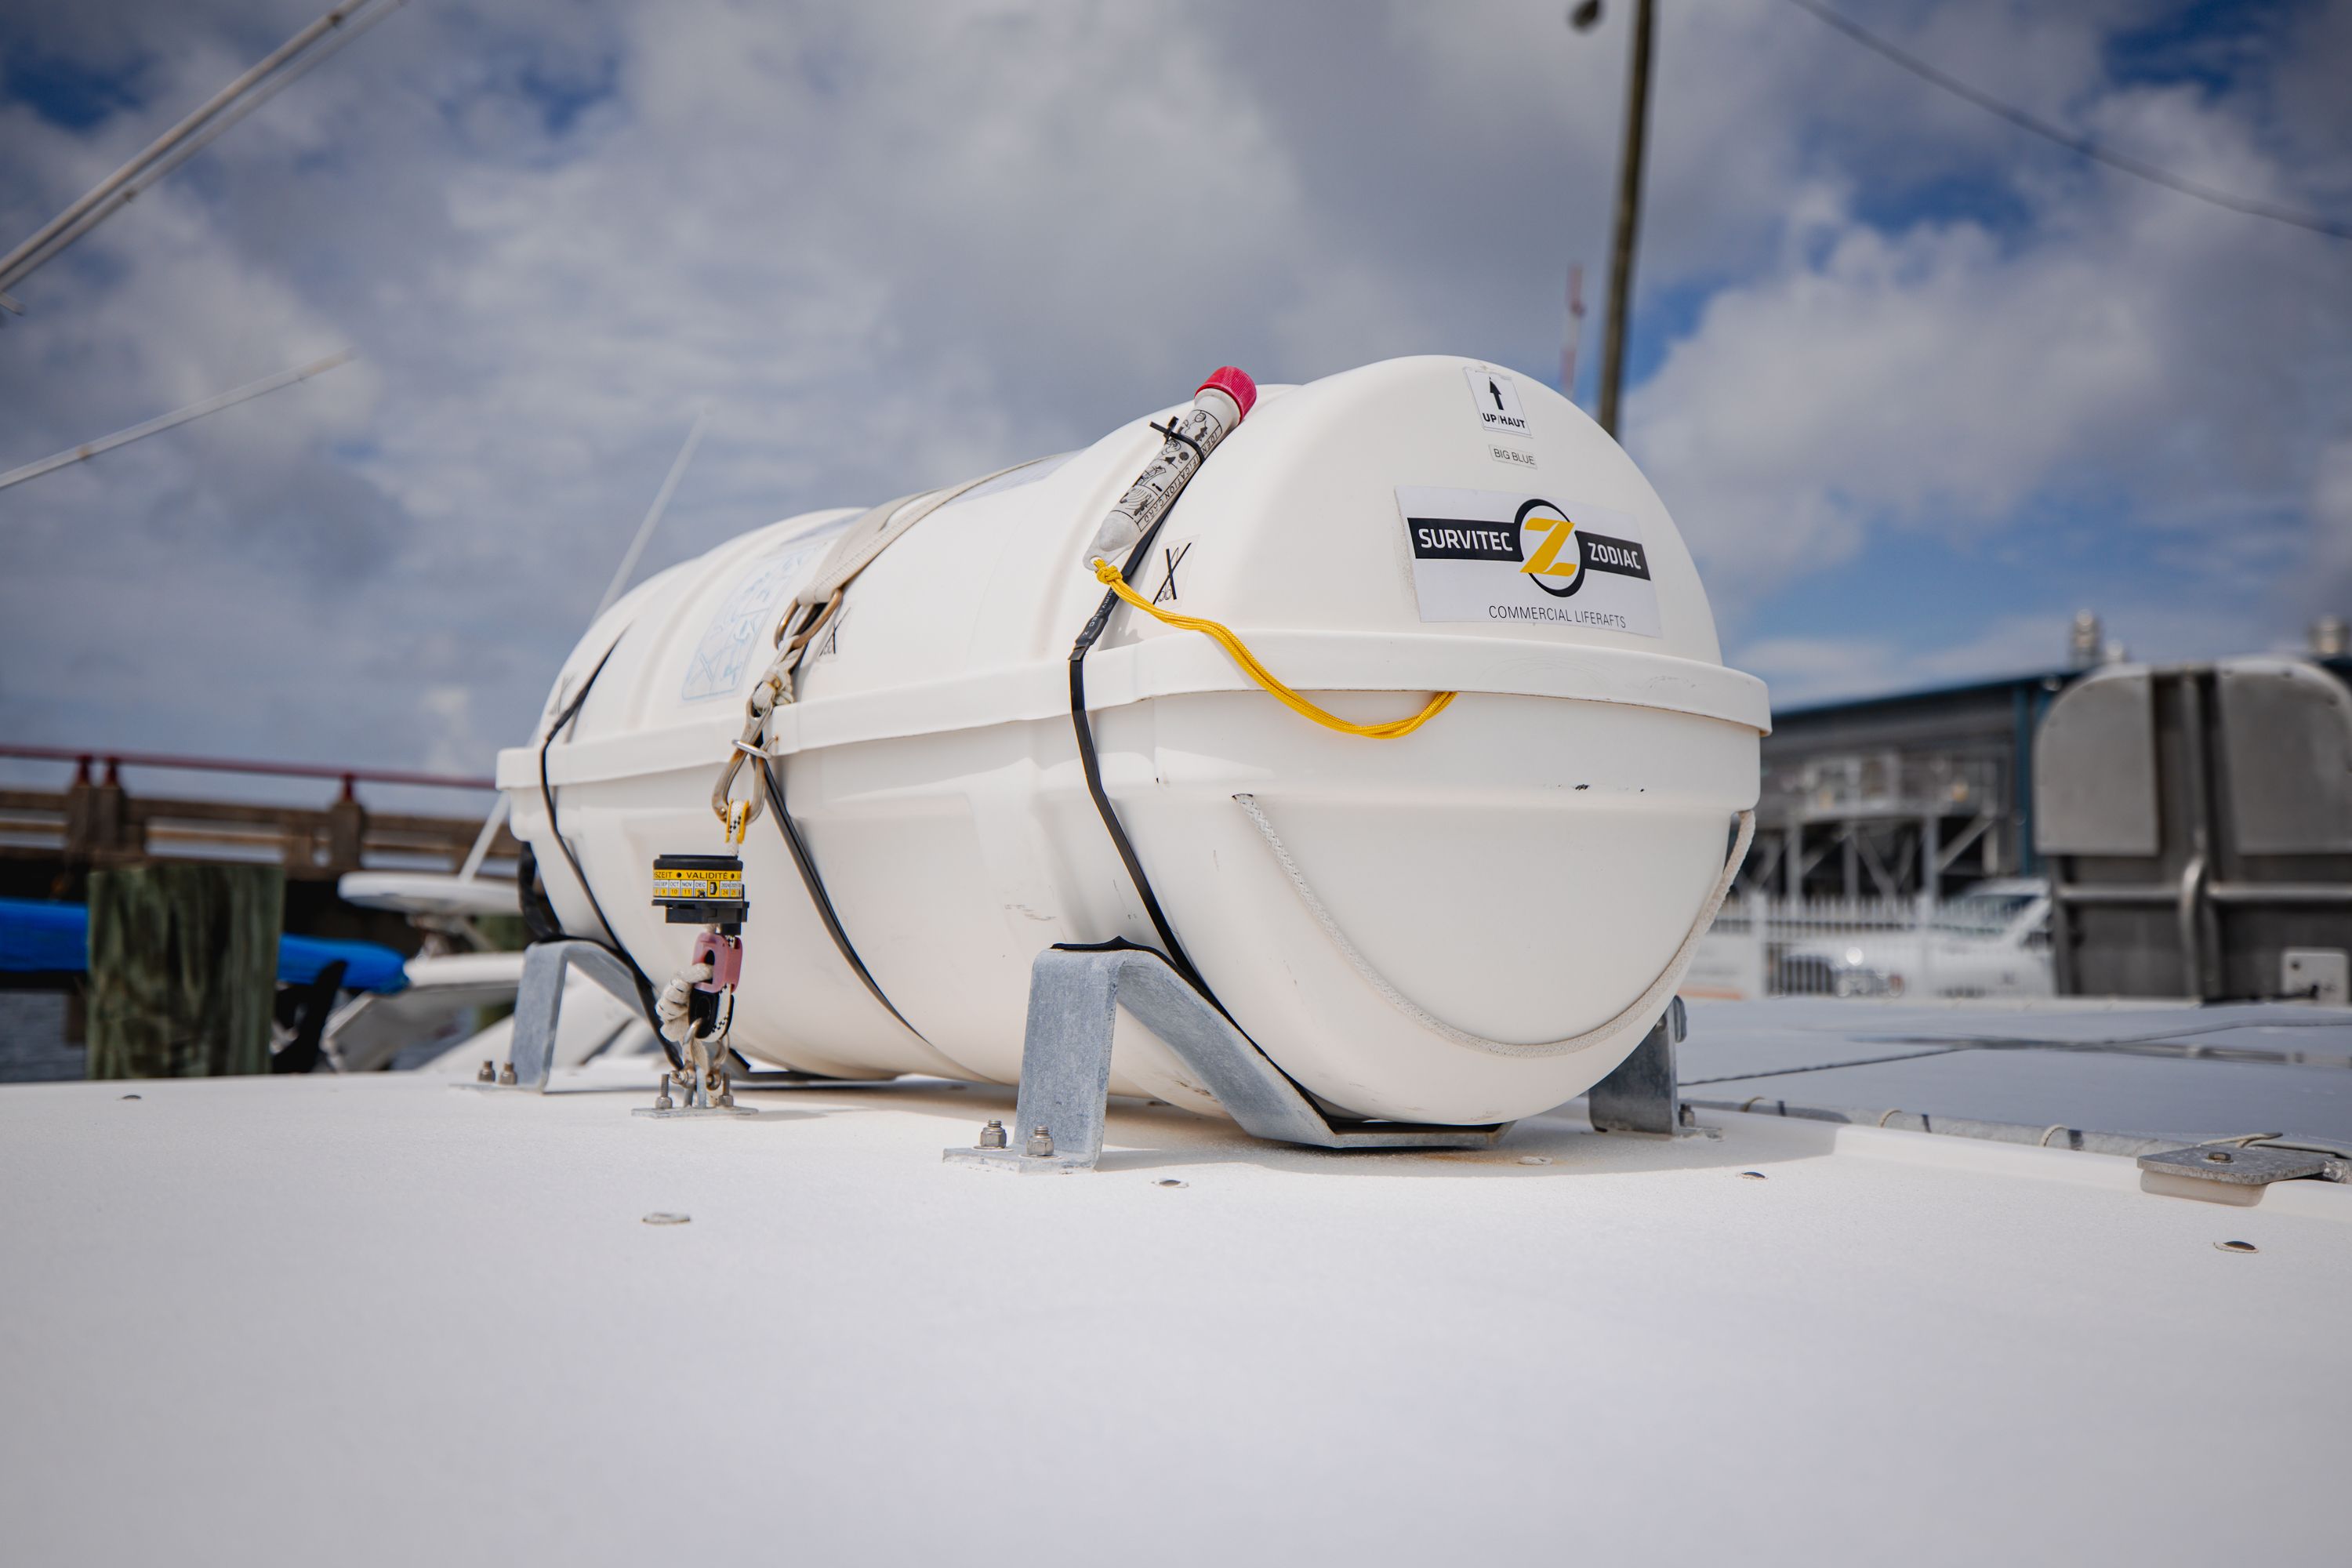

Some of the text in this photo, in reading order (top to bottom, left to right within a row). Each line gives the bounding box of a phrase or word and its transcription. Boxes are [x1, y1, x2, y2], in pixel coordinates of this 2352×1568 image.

[1494, 448, 1536, 465] BIG BLUE
[1144, 431, 1218, 523] IDENIFICATION CARD
[1417, 528, 1513, 552] SURVITEC
[1587, 542, 1642, 570] ZODIAC
[1488, 604, 1627, 628] COMMERCIAL LIFERAFTS
